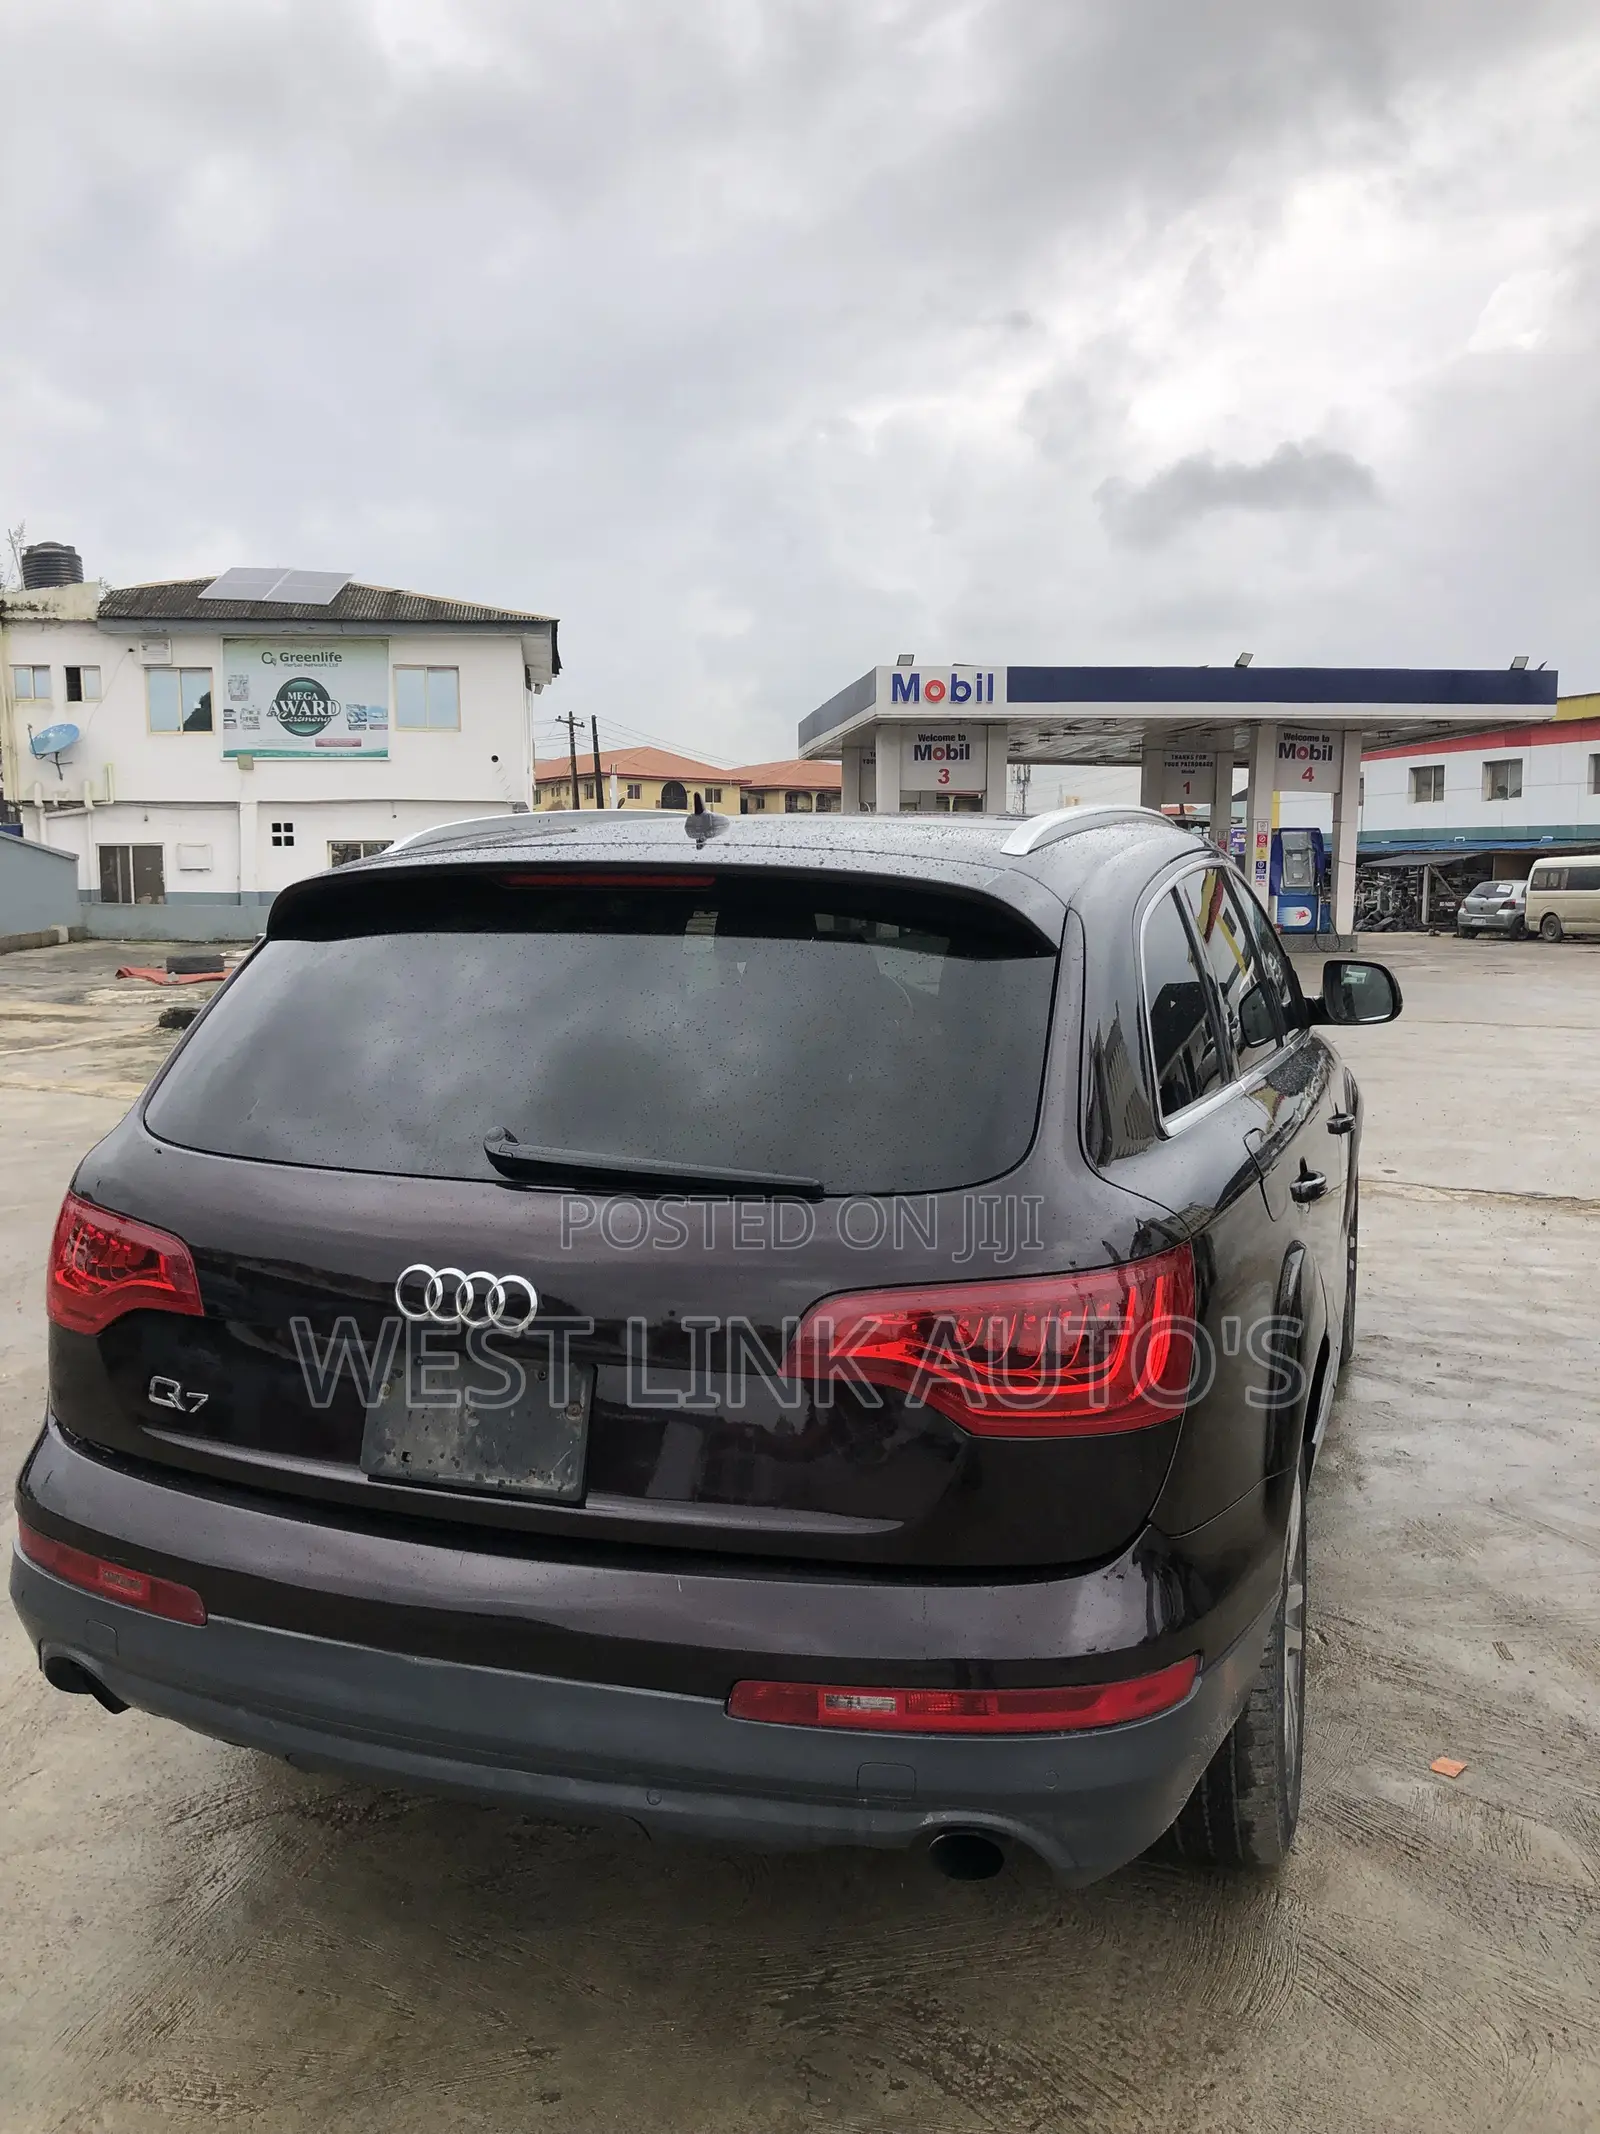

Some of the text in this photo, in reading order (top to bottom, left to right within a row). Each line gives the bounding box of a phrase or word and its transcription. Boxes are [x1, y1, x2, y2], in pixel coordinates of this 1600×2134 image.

[279, 651, 343, 663] Greenlife
[891, 672, 994, 703] Mobil
[287, 691, 319, 701] MEGA
[267, 699, 341, 717] AWARD
[277, 714, 333, 725] Ceremony
[917, 733, 967, 742] Welcome to
[1283, 732, 1330, 743] Welcome to
[913, 743, 970, 761] Mobil
[1278, 742, 1333, 762] Mobil
[937, 768, 950, 784] 3
[1301, 766, 1315, 782] 4
[1183, 781, 1191, 795] 1
[148, 1375, 209, 1413] Q7
